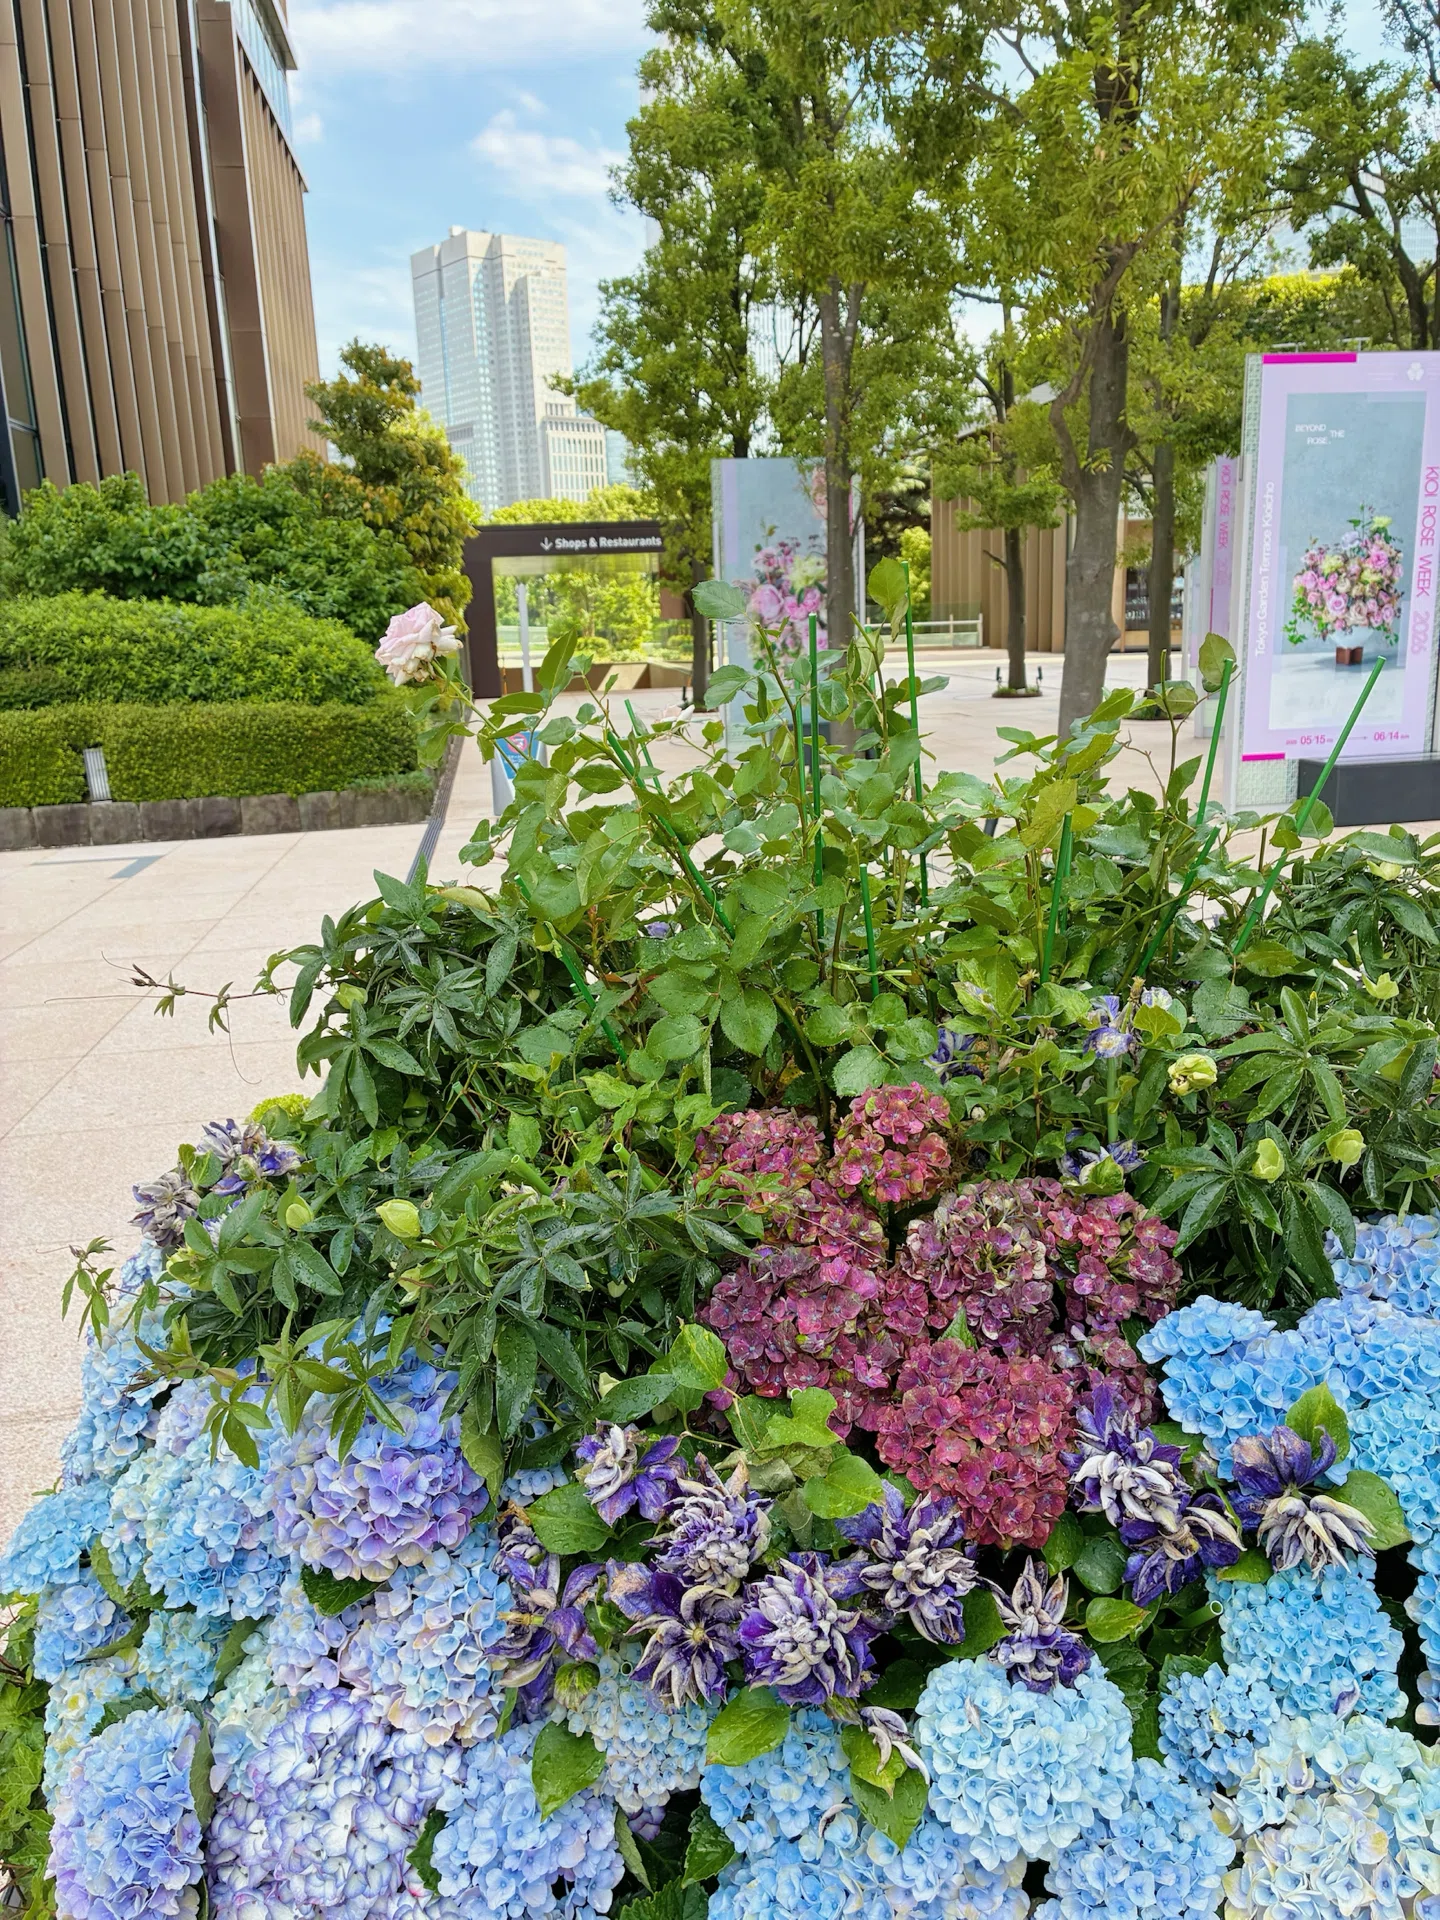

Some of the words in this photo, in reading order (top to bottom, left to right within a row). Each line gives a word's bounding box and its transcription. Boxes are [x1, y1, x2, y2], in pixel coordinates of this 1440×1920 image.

[1295, 424, 1326, 432] BEYOND
[1329, 430, 1345, 438] THE
[1221, 465, 1230, 486] KIOI
[1424, 466, 1439, 497] KIOI
[1220, 490, 1230, 516] ROSE
[1262, 481, 1275, 528] Kioicho
[1218, 522, 1229, 550] WEEK
[1420, 505, 1436, 547] ROSE
[555, 538, 588, 551] Shops
[589, 537, 598, 548] &
[599, 536, 662, 547] Restaurants
[1259, 529, 1272, 574] Terrace
[1416, 553, 1433, 597] WEEK
[1257, 575, 1269, 620] Garden
[1255, 621, 1269, 657] Tokyo
[1411, 610, 1430, 655] 2026
